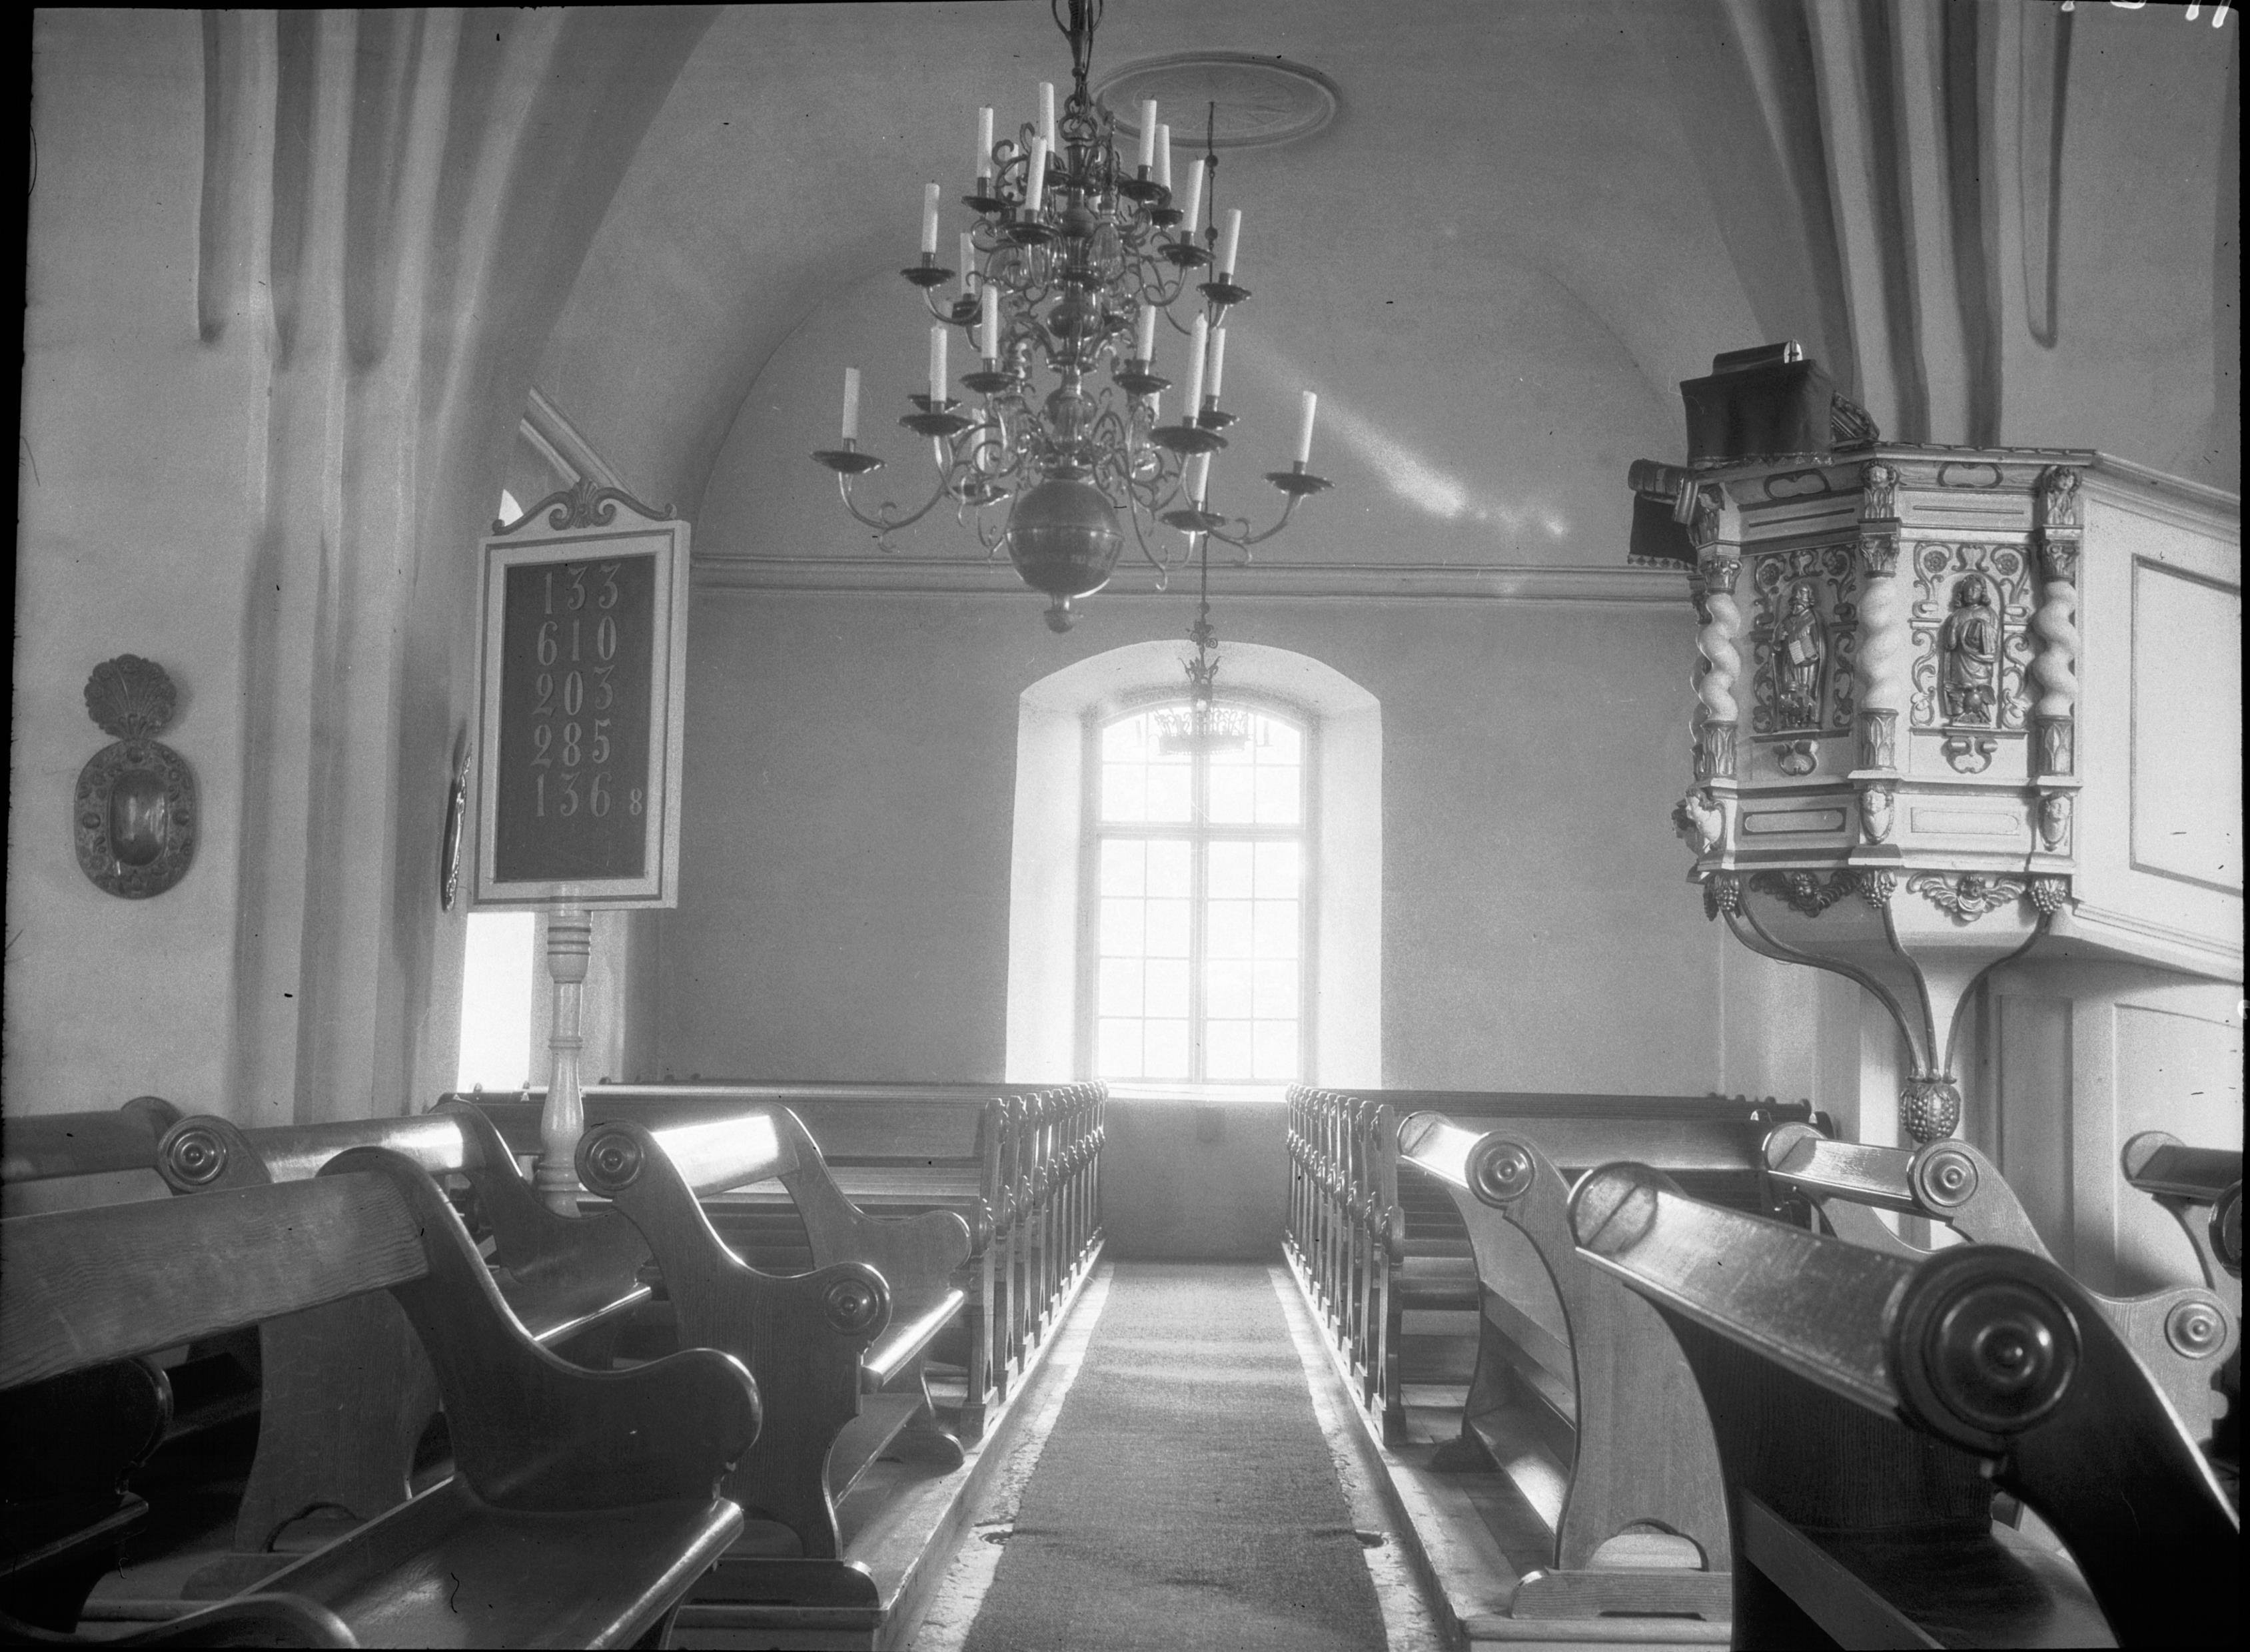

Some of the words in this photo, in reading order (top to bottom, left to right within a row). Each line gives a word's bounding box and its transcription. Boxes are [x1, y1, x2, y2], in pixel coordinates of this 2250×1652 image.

[544, 563, 622, 614] 133
[537, 616, 617, 665] 610
[534, 665, 614, 716] 203
[532, 718, 611, 767] 285
[536, 771, 611, 817] 136
[629, 787, 643, 816] 8
